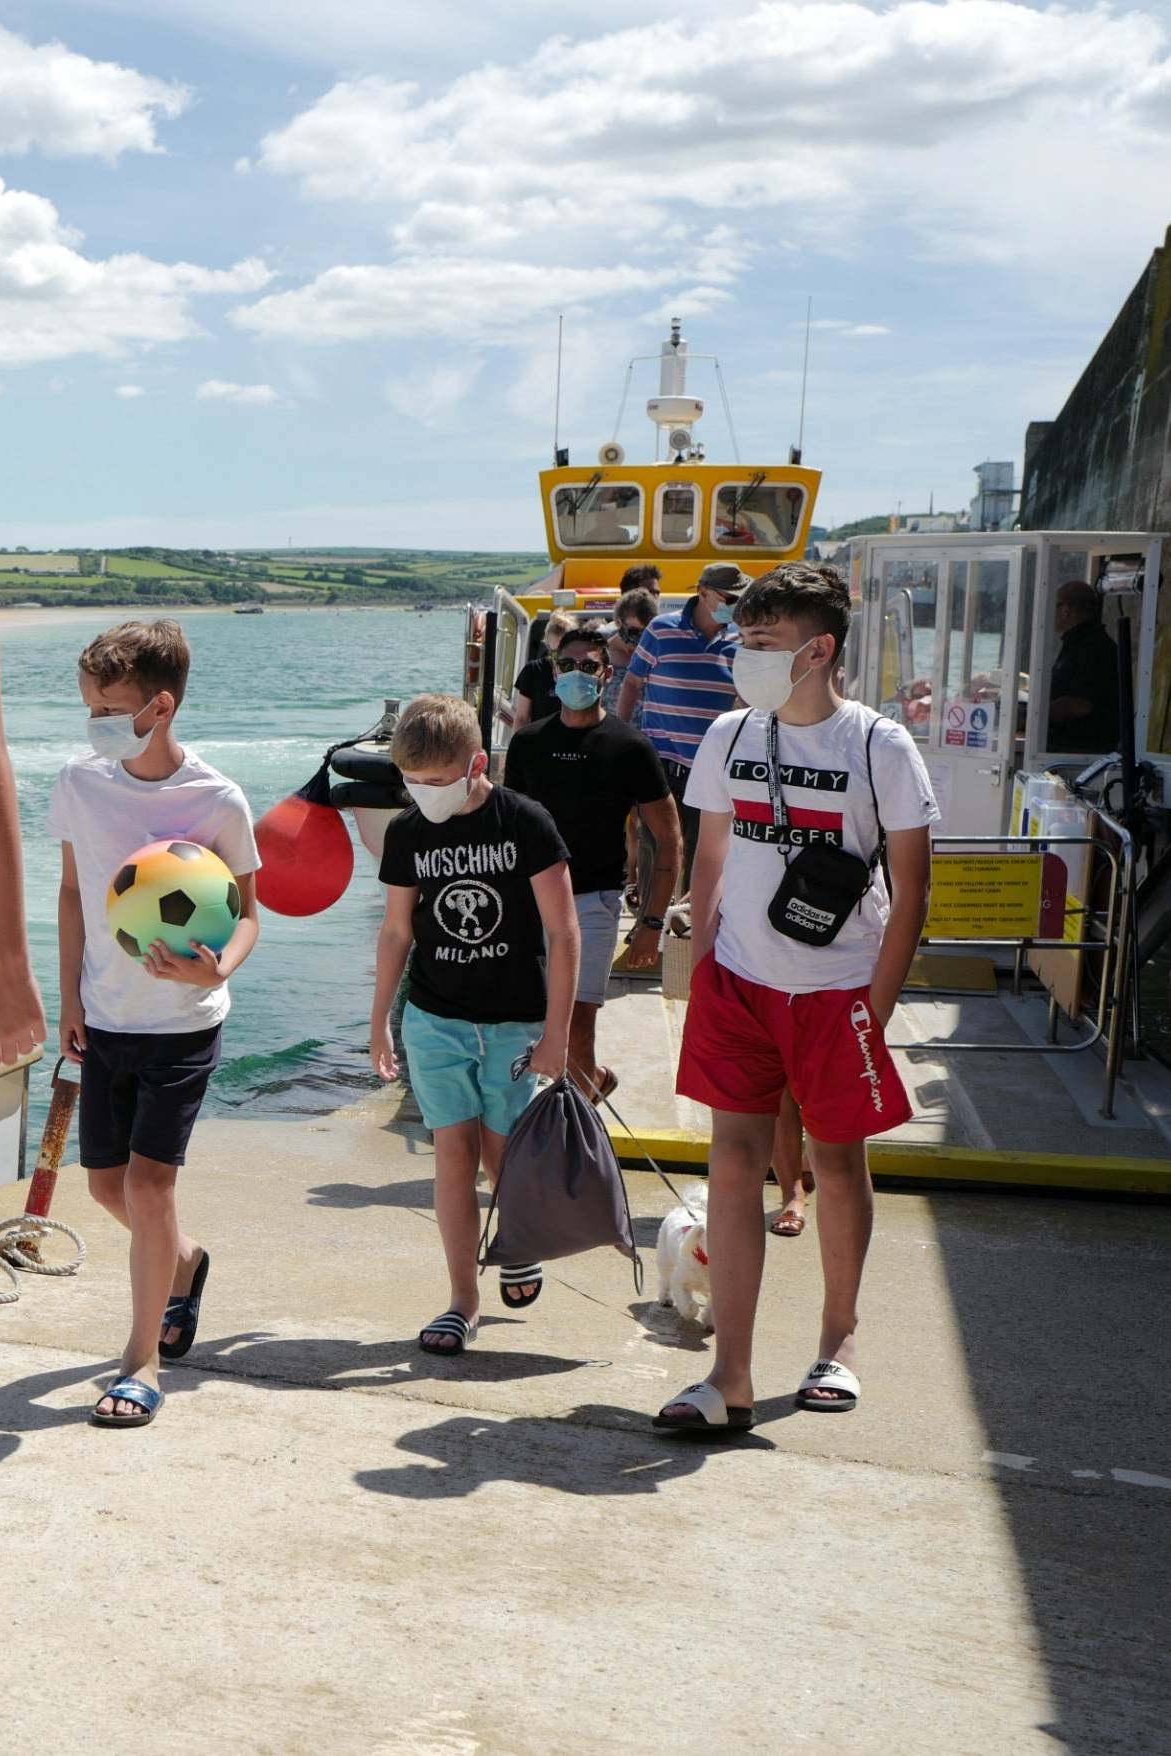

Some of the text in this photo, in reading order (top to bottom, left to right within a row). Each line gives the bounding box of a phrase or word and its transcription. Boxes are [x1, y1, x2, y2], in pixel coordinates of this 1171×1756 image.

[734, 761, 844, 789] TOMMY
[414, 840, 518, 879] MOSCHINO
[785, 911, 815, 930] adidas
[790, 902, 820, 920] adidas
[435, 942, 509, 963] MILANO
[850, 1000, 883, 1113] Champion
[813, 1362, 842, 1376] NIKE
